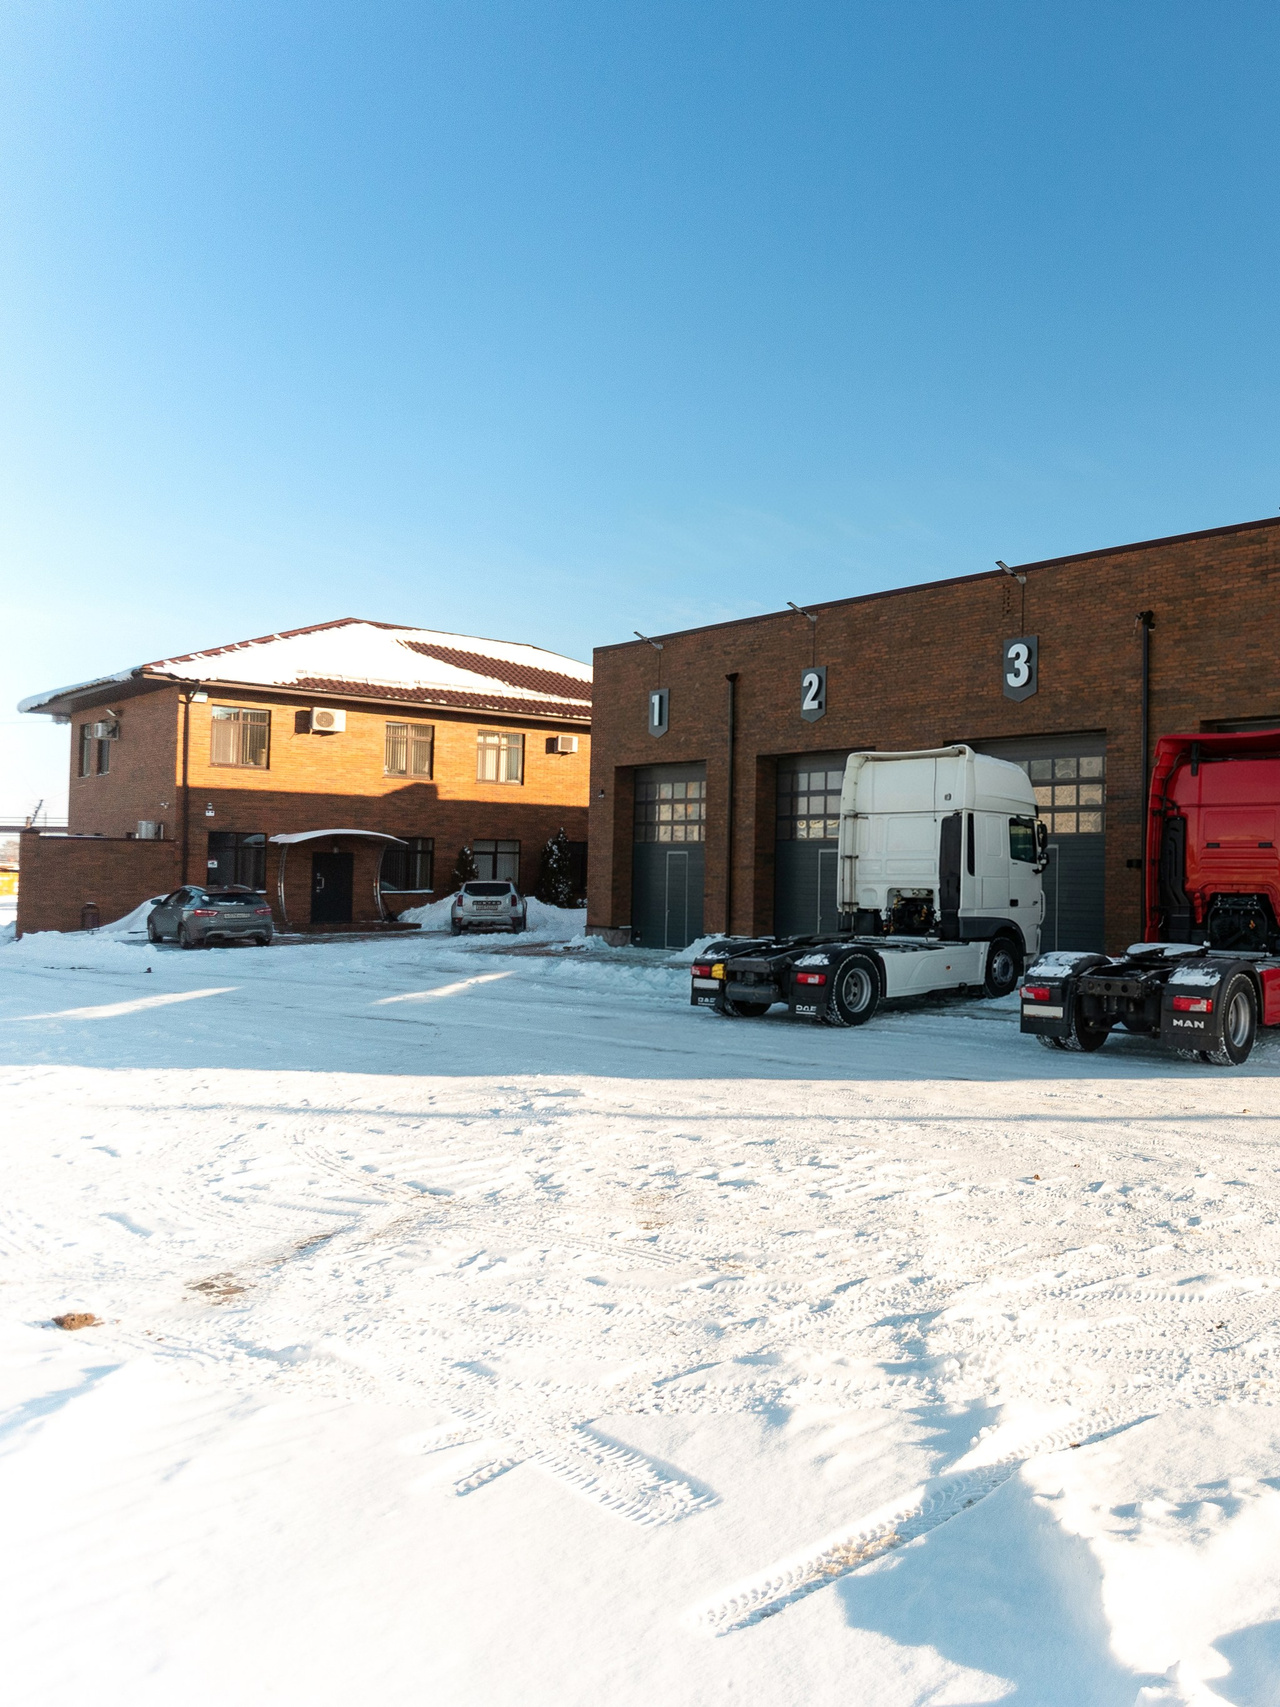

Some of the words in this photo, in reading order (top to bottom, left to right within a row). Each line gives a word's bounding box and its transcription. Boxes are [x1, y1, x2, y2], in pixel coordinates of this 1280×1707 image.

[1006, 643, 1029, 687] 3
[802, 672, 819, 710] 2
[651, 694, 660, 726] 1
[1172, 1018, 1205, 1029] MAN
